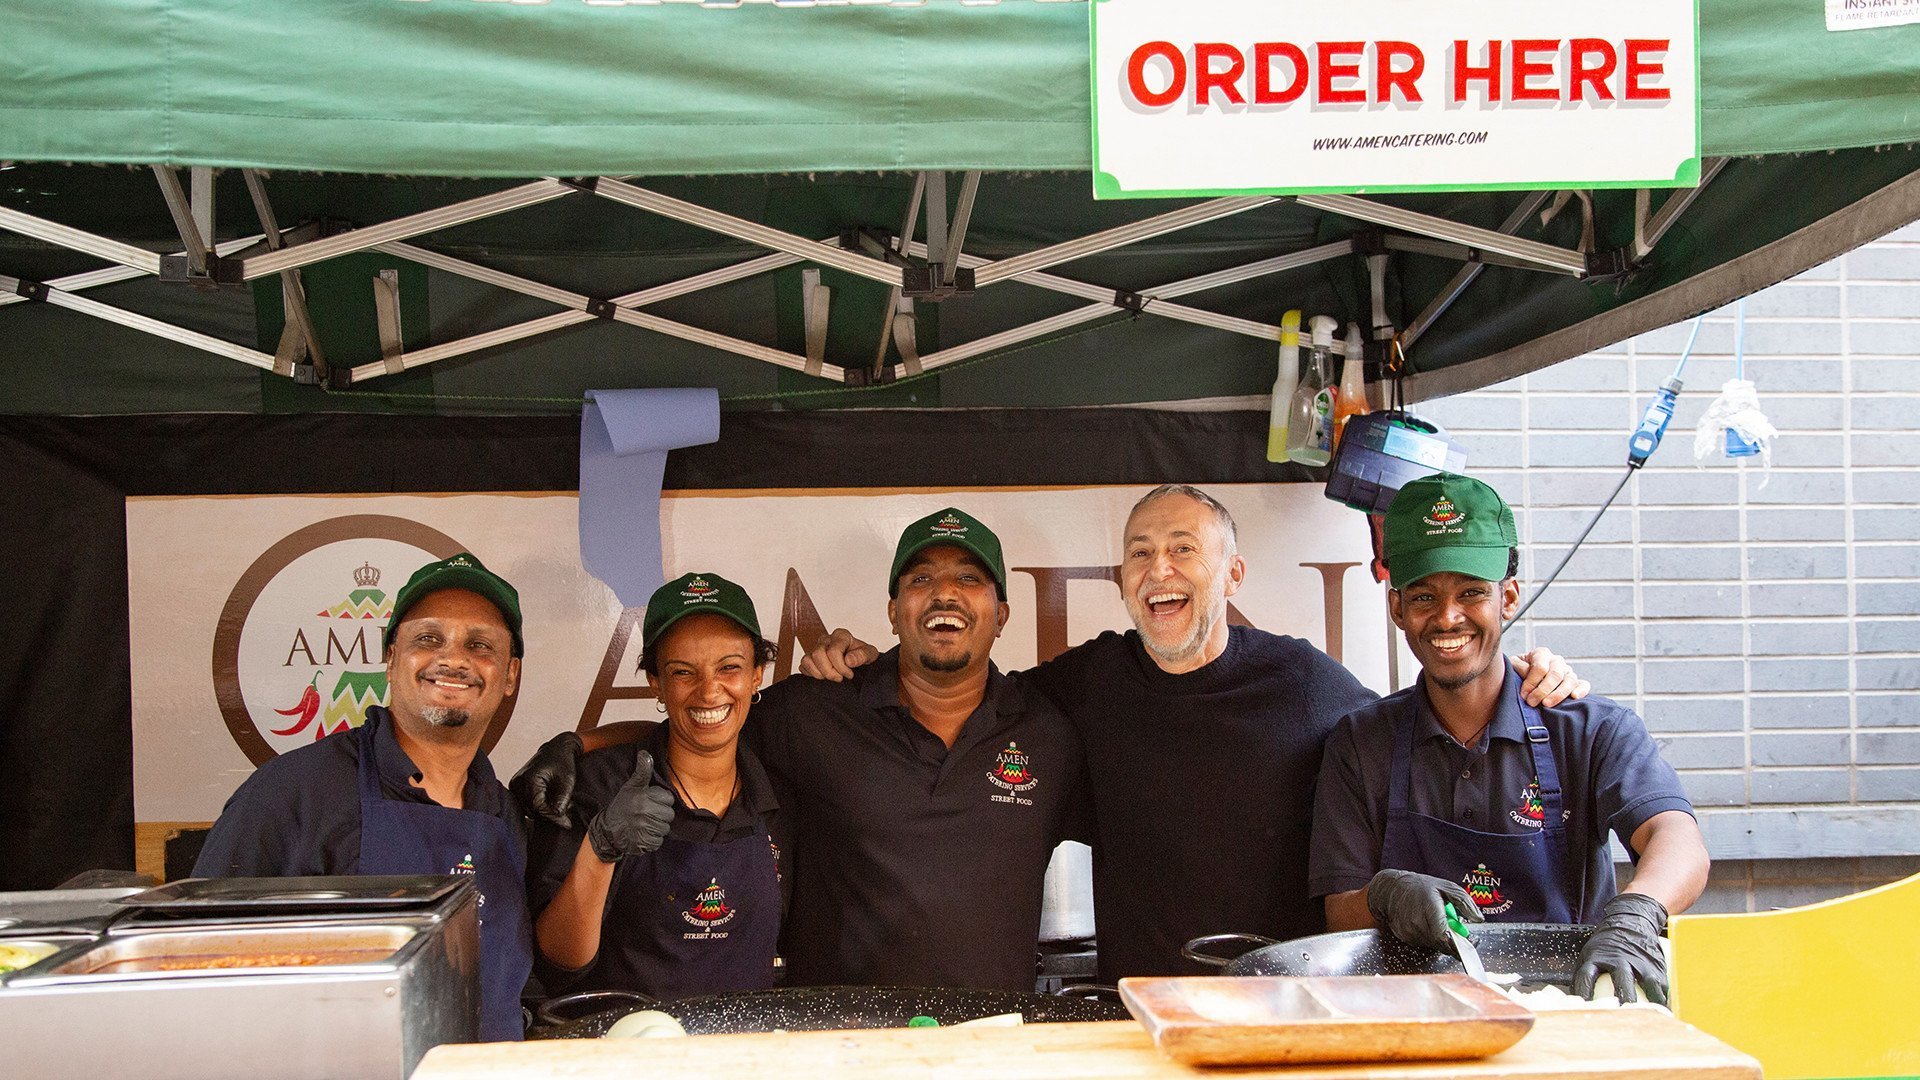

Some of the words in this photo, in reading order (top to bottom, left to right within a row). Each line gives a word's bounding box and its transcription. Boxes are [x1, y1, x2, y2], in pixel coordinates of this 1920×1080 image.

[1125, 40, 1426, 108] ORDER
[1453, 38, 1672, 105] HERE
[1312, 130, 1489, 151] WWW.AMENCATERING.COM
[1431, 503, 1454, 512] AMEN
[995, 752, 1030, 766] AMEN
[985, 772, 1013, 790] CATERING
[1013, 777, 1039, 792] SERVICES
[990, 794, 1015, 804] STREET
[1016, 797, 1033, 806] FOOD
[1509, 810, 1542, 828] CATERING
[1462, 873, 1502, 887] AMEN
[695, 889, 726, 902] AMEN
[1482, 899, 1513, 915] SERVICES
[681, 910, 709, 927] CATERING
[709, 909, 736, 927] SERVICES
[683, 932, 710, 940] STREET
